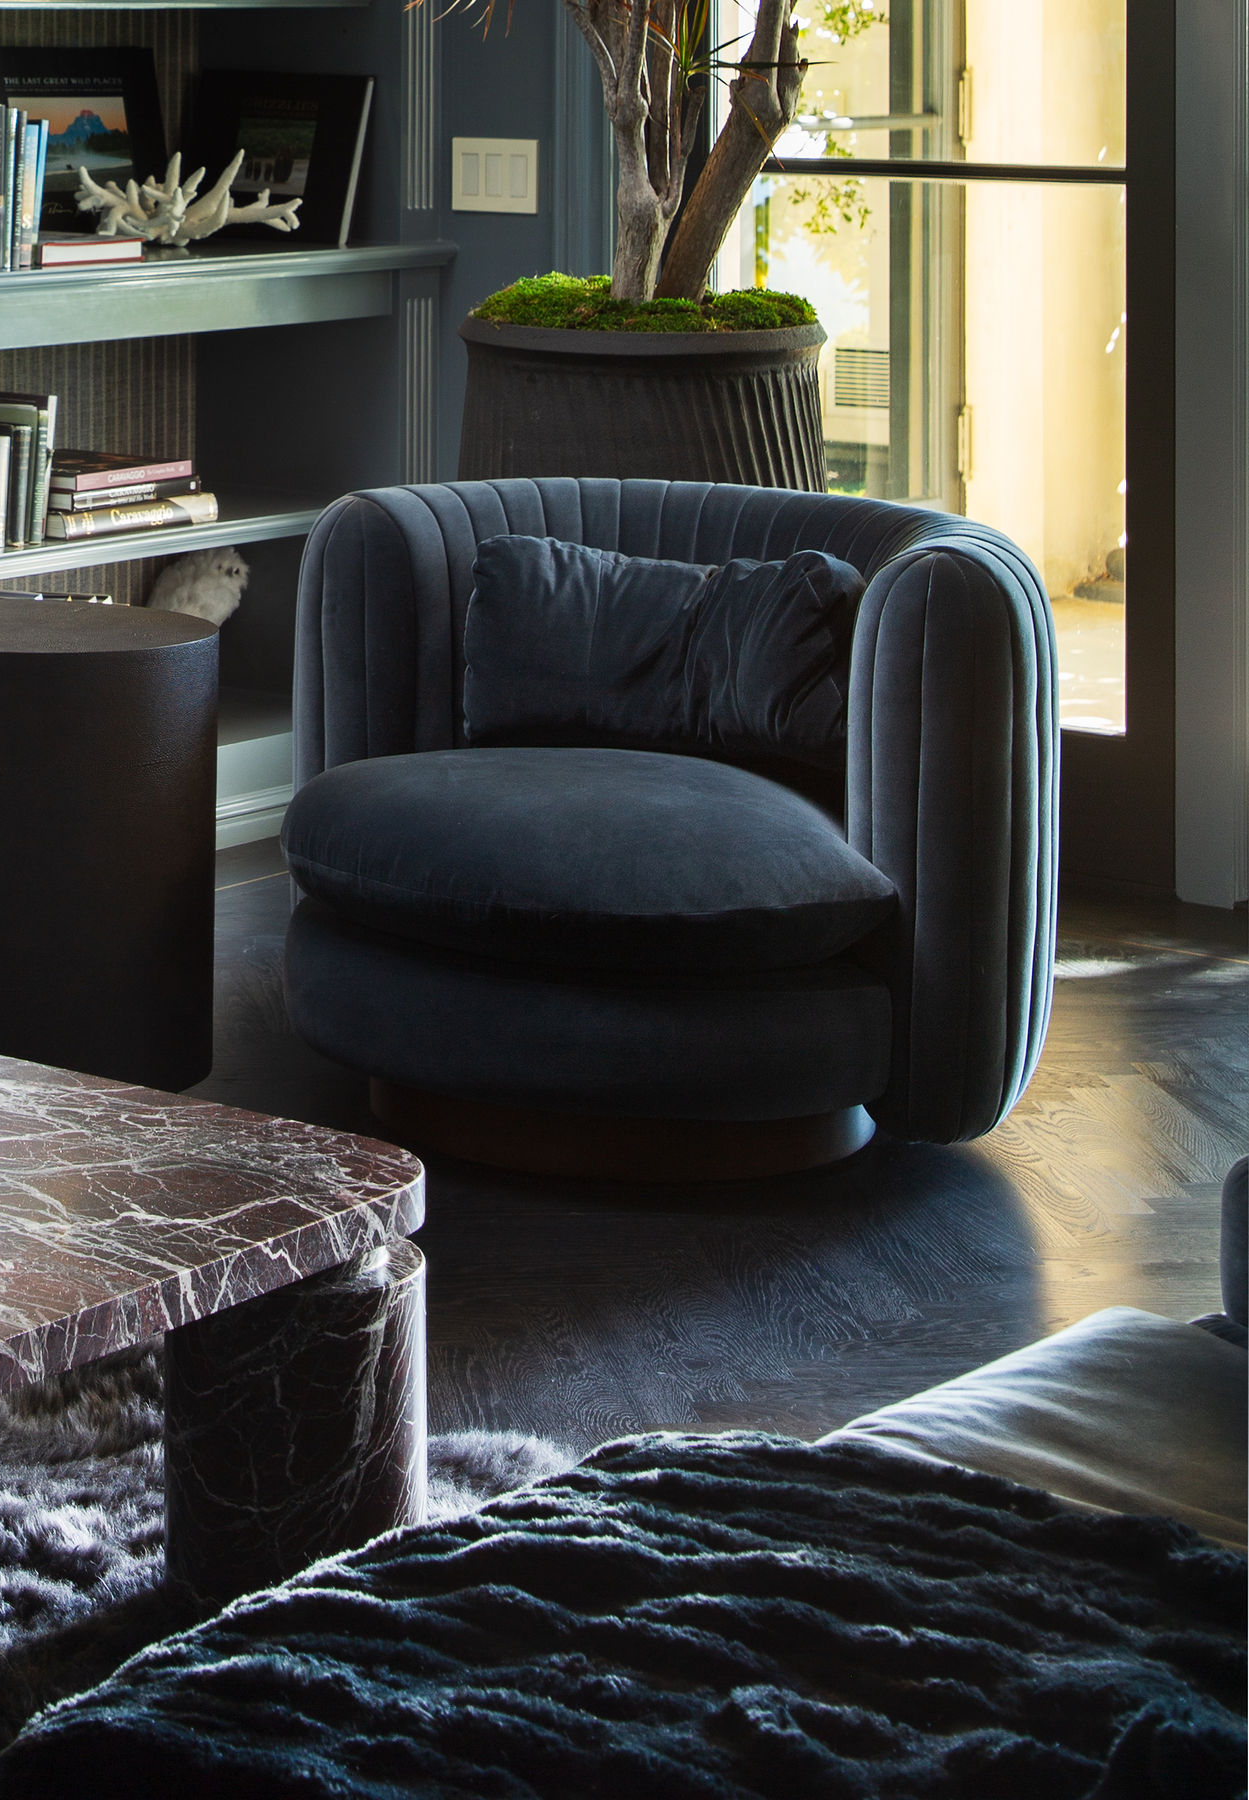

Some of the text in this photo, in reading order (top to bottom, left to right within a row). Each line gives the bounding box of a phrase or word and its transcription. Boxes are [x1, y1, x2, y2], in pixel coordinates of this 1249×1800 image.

[3, 76, 19, 86] THE
[21, 77, 42, 86] LAST
[43, 77, 70, 86] GREAT
[16, 163, 24, 190] Reign
[110, 504, 174, 526] Caravaggio
